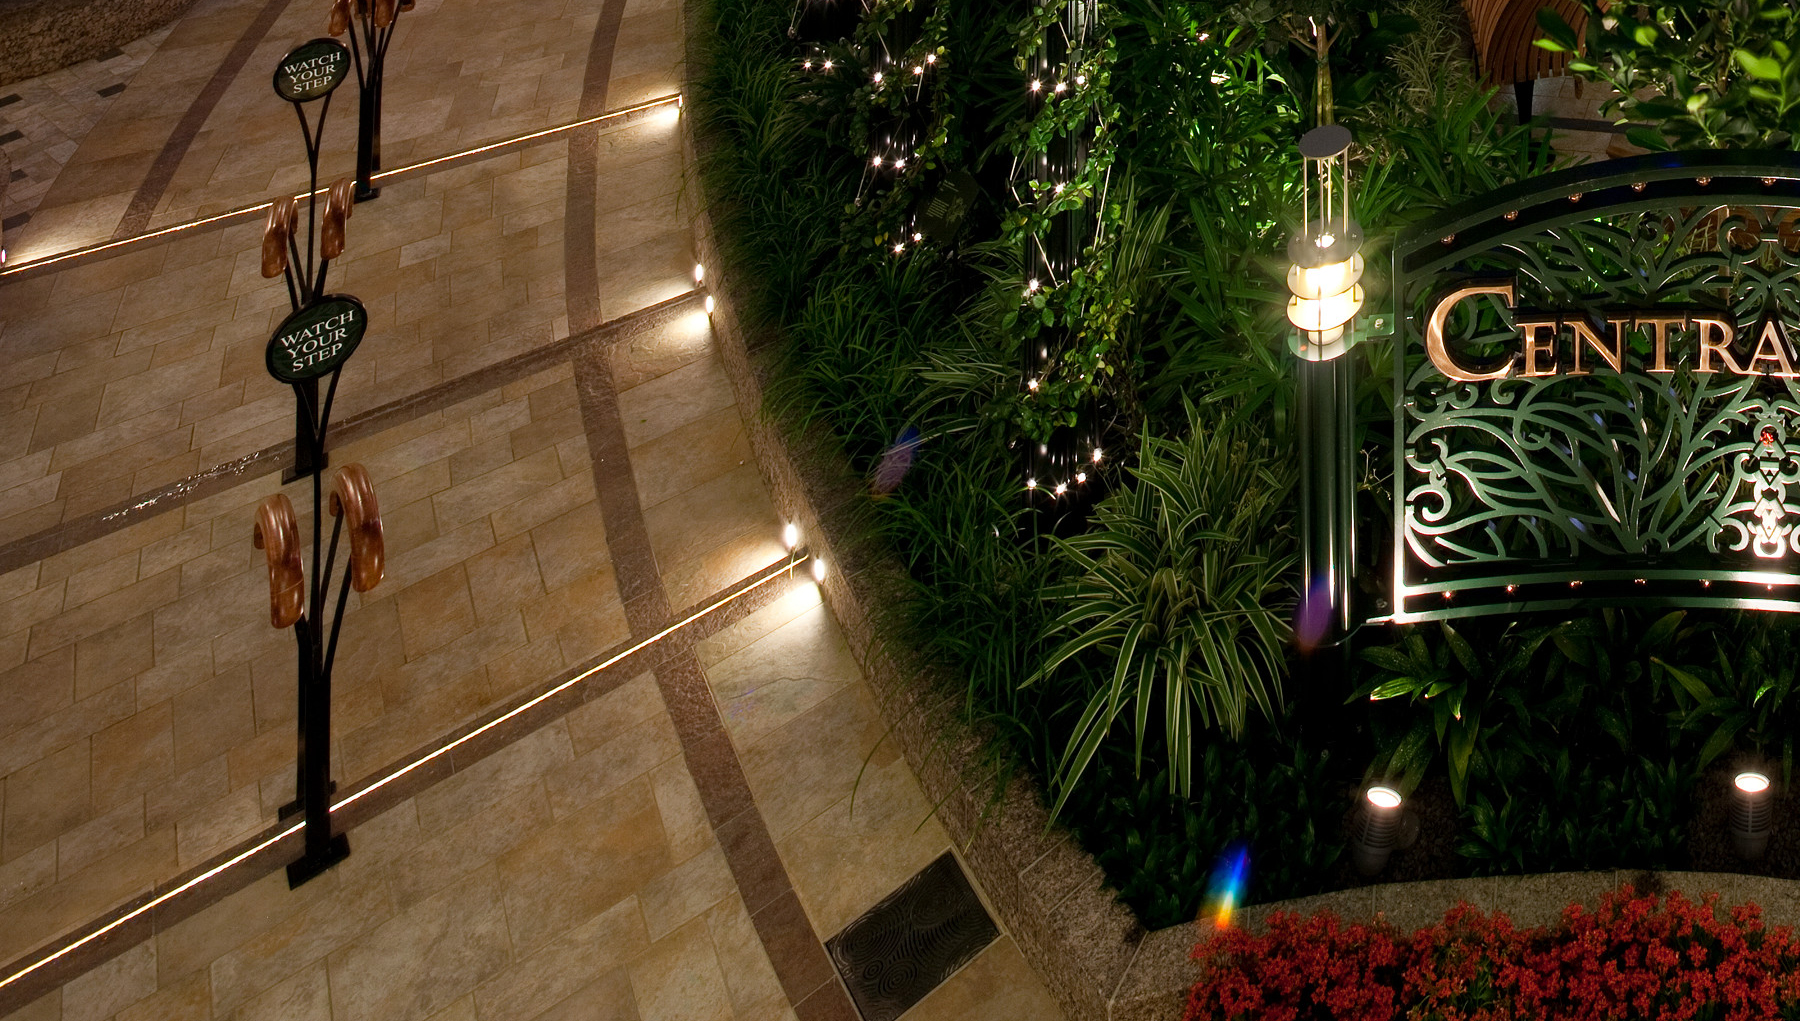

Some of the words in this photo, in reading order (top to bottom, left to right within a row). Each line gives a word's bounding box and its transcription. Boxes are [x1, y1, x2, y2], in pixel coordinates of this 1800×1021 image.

[284, 51, 342, 74] WATCH
[289, 64, 337, 84] YOUR
[293, 75, 332, 94] STEP
[280, 309, 355, 348] WATCH
[286, 327, 348, 359] YOUR
[292, 342, 343, 372] STEP
